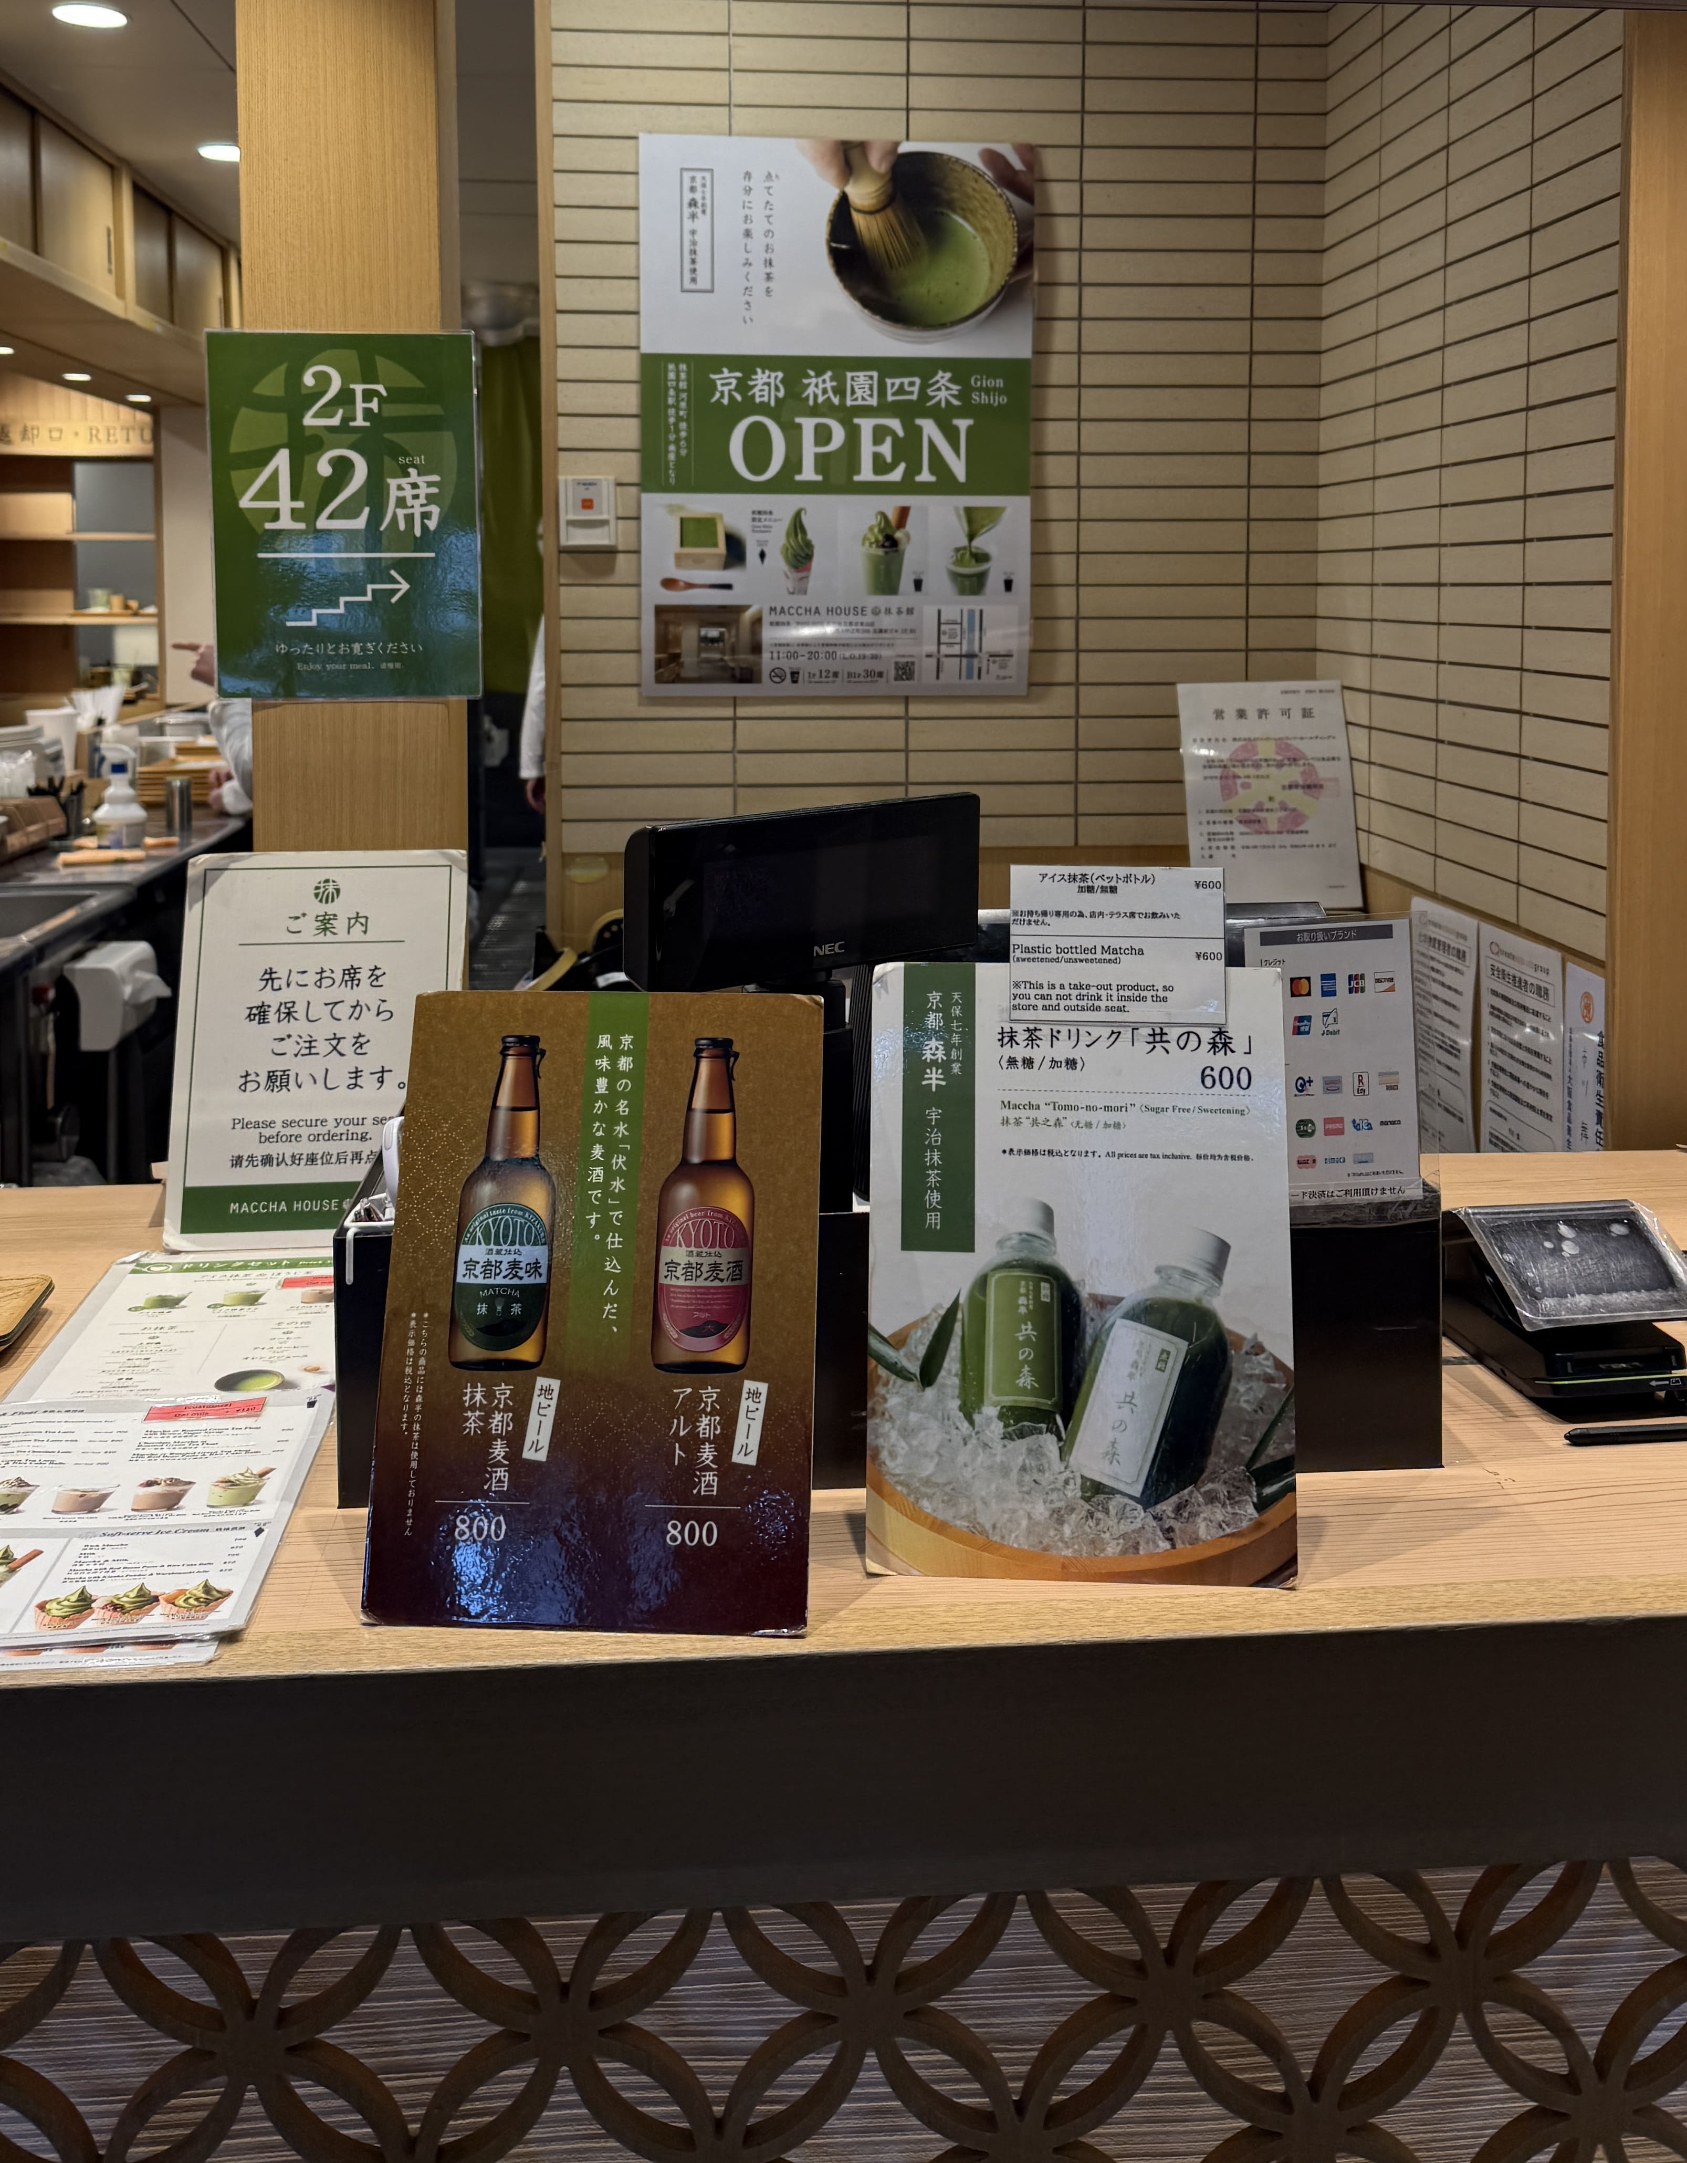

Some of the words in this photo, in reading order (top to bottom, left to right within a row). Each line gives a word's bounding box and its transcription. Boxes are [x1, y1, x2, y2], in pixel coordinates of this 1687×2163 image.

[742, 171, 753, 324] 存分にお楽しみください
[709, 368, 785, 407] 京都
[801, 369, 963, 408] 祇園四条
[971, 376, 1004, 388] Gion
[303, 365, 388, 427] 2F
[971, 391, 1008, 405] Shijo
[398, 455, 425, 465] seat
[729, 415, 974, 483] OPEN
[769, 606, 821, 616] MACCHA
[826, 606, 867, 616] HOUSE
[275, 642, 423, 656] ゆったりとお寛ぎください
[297, 662, 321, 671] Enjoy
[326, 663, 347, 671] your
[1213, 707, 1316, 721] 営業許可証
[1077, 885, 1118, 894] 加糖/無糖
[1194, 880, 1222, 890] ¥600
[286, 911, 370, 937] ご案内
[1012, 918, 1051, 927] だけません。
[813, 941, 845, 957] NEC
[1297, 929, 1357, 943] お取り扱いブランド
[1012, 944, 1052, 954] Plastic
[1055, 944, 1097, 955] bottled
[1101, 945, 1145, 956] Matcha
[1195, 951, 1223, 961] ¥600
[1012, 955, 1121, 965] (sweetened/unsweetened)
[258, 966, 387, 992] 先にお席を
[1047, 981, 1057, 990] is
[1068, 982, 1114, 992] take-out
[1116, 982, 1158, 993] product,
[926, 991, 944, 1031] 京都
[1012, 993, 1031, 1002] you
[1075, 993, 1103, 1001] drink
[1106, 993, 1114, 1001] it
[1116, 994, 1147, 1002] inside
[1151, 994, 1168, 1003] the
[1012, 1003, 1038, 1011] store
[1041, 1003, 1061, 1011] and
[1063, 1003, 1102, 1012] outside
[1104, 1003, 1130, 1012] seat.
[244, 999, 394, 1025] 確保してから
[270, 1032, 371, 1059] ご注文を
[950, 991, 963, 1075] 天保七年創業
[997, 1026, 1253, 1056] 抹茶ドリンク「共の森」
[921, 1038, 947, 1092] 森半
[1200, 1065, 1252, 1090] 600
[238, 1066, 407, 1093] お願いします。
[1000, 1101, 1041, 1111] Maccha
[231, 1118, 276, 1130] Please
[281, 1118, 328, 1129] secure
[333, 1117, 367, 1129] your
[258, 1130, 303, 1143] before
[307, 1129, 373, 1142] ordering.
[585, 1034, 613, 1241] 風味豊かな麦酒です。
[924, 1107, 943, 1230] 宇治抹茶使用
[1117, 1152, 1137, 1160] prices
[1161, 1152, 1193, 1160] inclusive.
[602, 1034, 635, 1333] 京都の名水「伏水」で仕込んだ、
[230, 1201, 287, 1214] MACCHA
[293, 1199, 340, 1212] HOUSE
[476, 1216, 535, 1246] KYOTO
[676, 1219, 735, 1249] KYOTO
[663, 1259, 743, 1283] 京都麦酒
[480, 1287, 520, 1298] MATCHA
[1014, 1321, 1039, 1390] 共の森
[462, 1383, 488, 1436] 抹茶
[528, 1384, 554, 1454] 地ビール
[669, 1388, 692, 1466] アルト
[736, 1387, 762, 1459] 地ビール
[1102, 1391, 1138, 1466] 共の森
[484, 1383, 514, 1492] 京都麦酒
[692, 1386, 721, 1496] 京都麦酒
[173, 1527, 210, 1535] Cream
[455, 1515, 507, 1541] 800
[666, 1520, 718, 1546] 800
